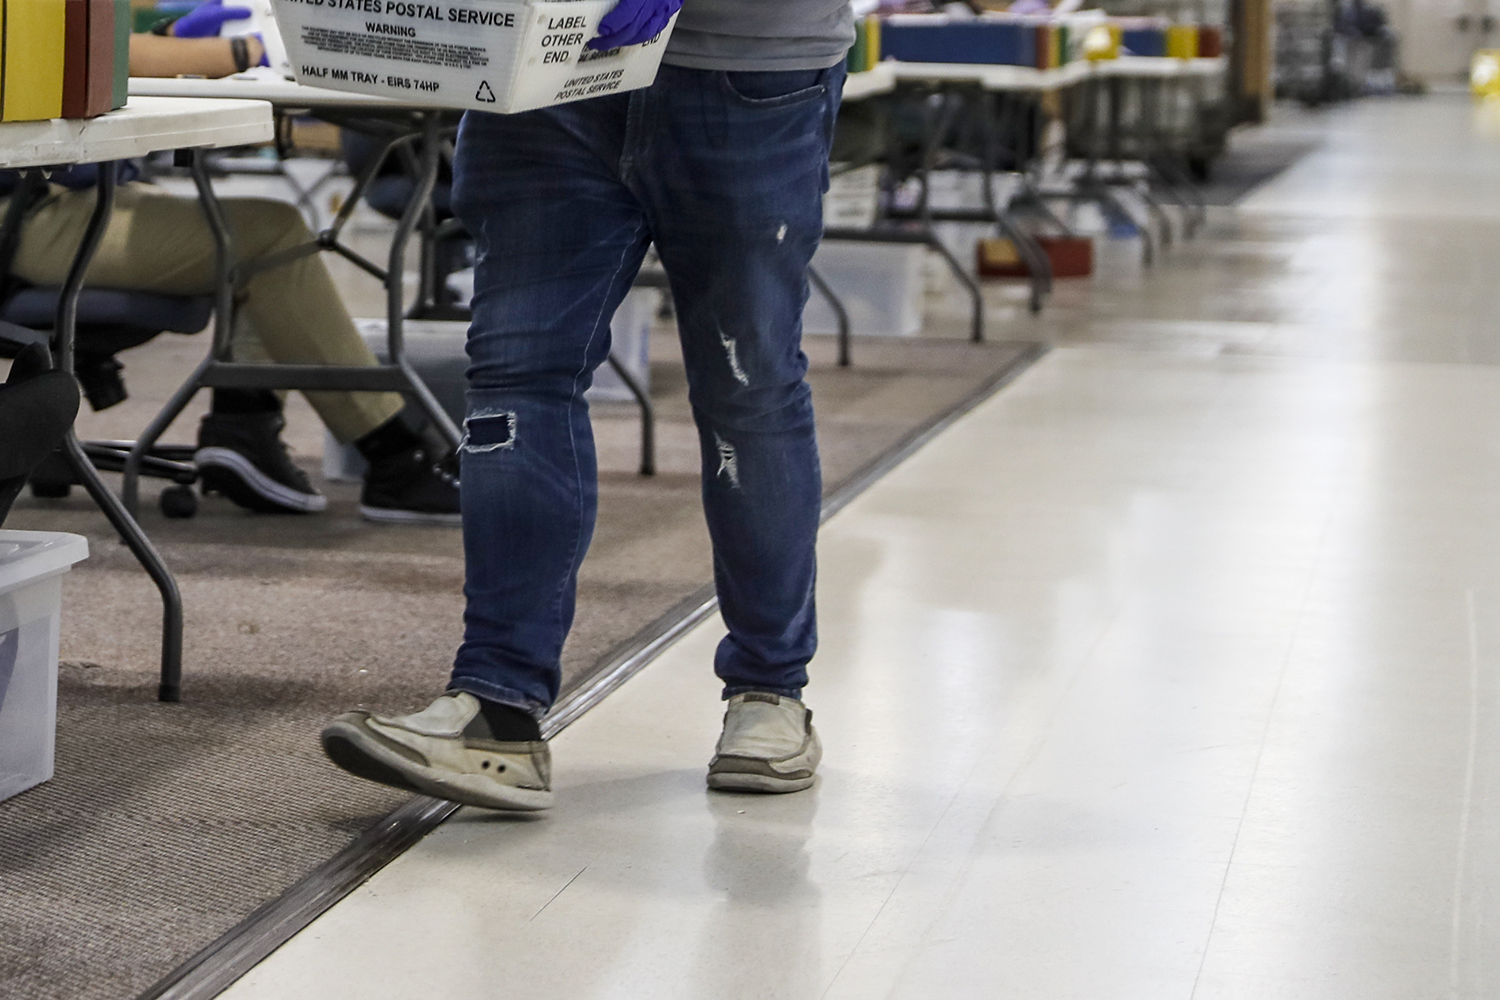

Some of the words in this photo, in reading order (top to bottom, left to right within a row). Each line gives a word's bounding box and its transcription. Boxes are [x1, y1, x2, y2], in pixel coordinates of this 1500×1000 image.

[386, 2, 444, 21] POSTAL
[448, 8, 515, 27] SERVICE
[548, 16, 586, 30] LABEL
[365, 22, 416, 37] WARNING
[541, 33, 584, 47] OTHER
[543, 50, 569, 64] END
[302, 65, 329, 78] HALF
[331, 69, 349, 81] MM
[351, 71, 378, 84] TRAY
[387, 76, 412, 89] EIRS
[413, 80, 440, 93] 74HP
[564, 75, 594, 89] UNITED
[593, 69, 625, 83] STATES
[554, 88, 586, 101] POSTAL
[586, 80, 622, 95] SERVICE
